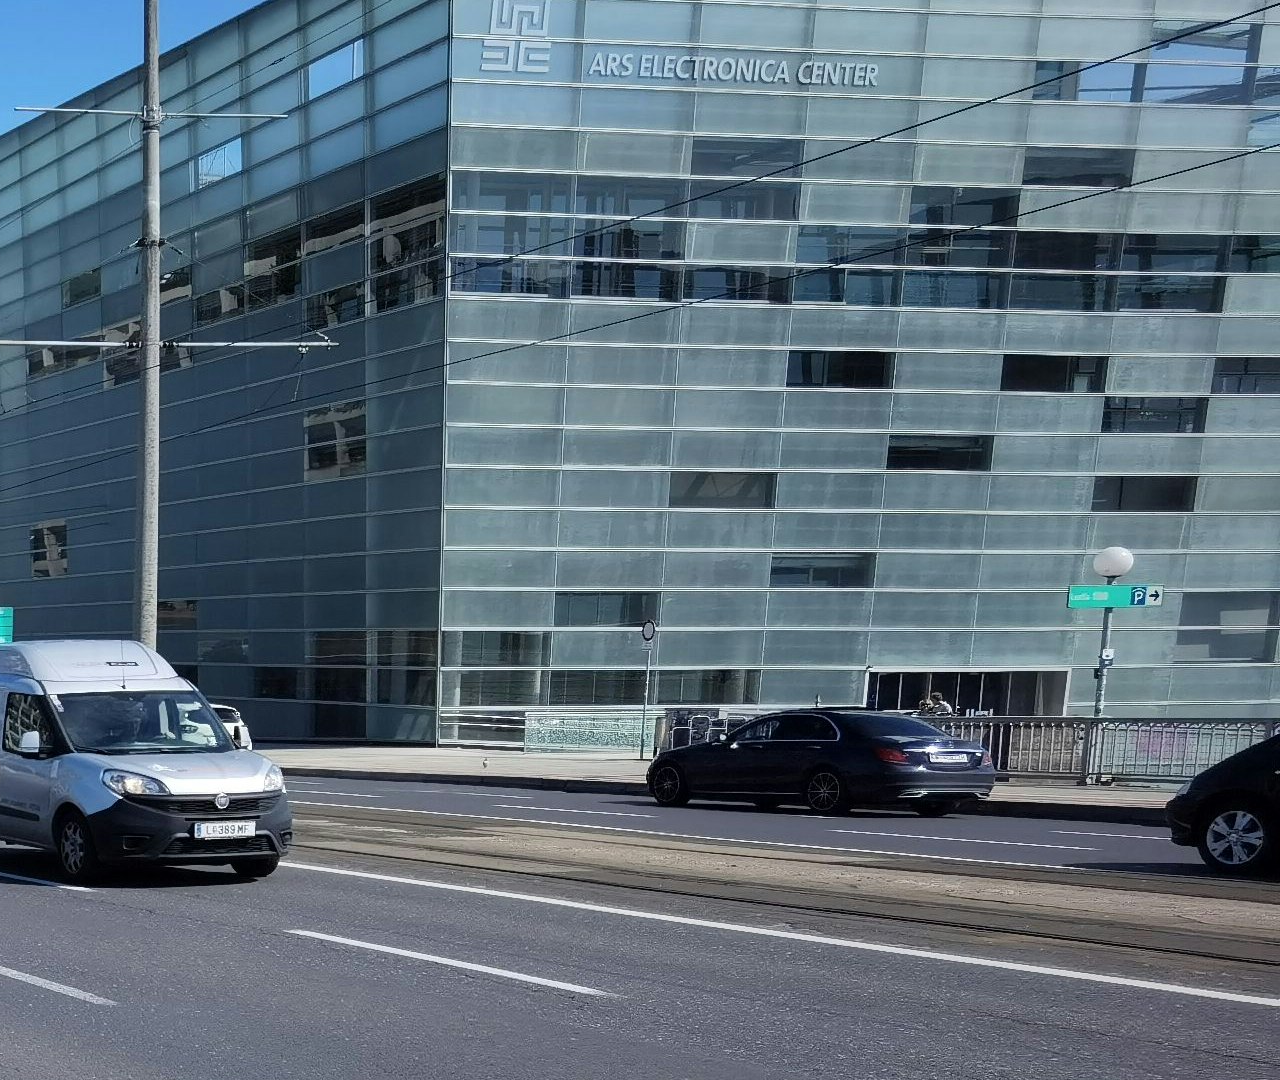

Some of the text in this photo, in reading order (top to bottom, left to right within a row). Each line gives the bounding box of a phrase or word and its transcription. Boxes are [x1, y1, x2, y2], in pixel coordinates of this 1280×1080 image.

[589, 51, 879, 87] ARS ELECTRONICA CENTER
